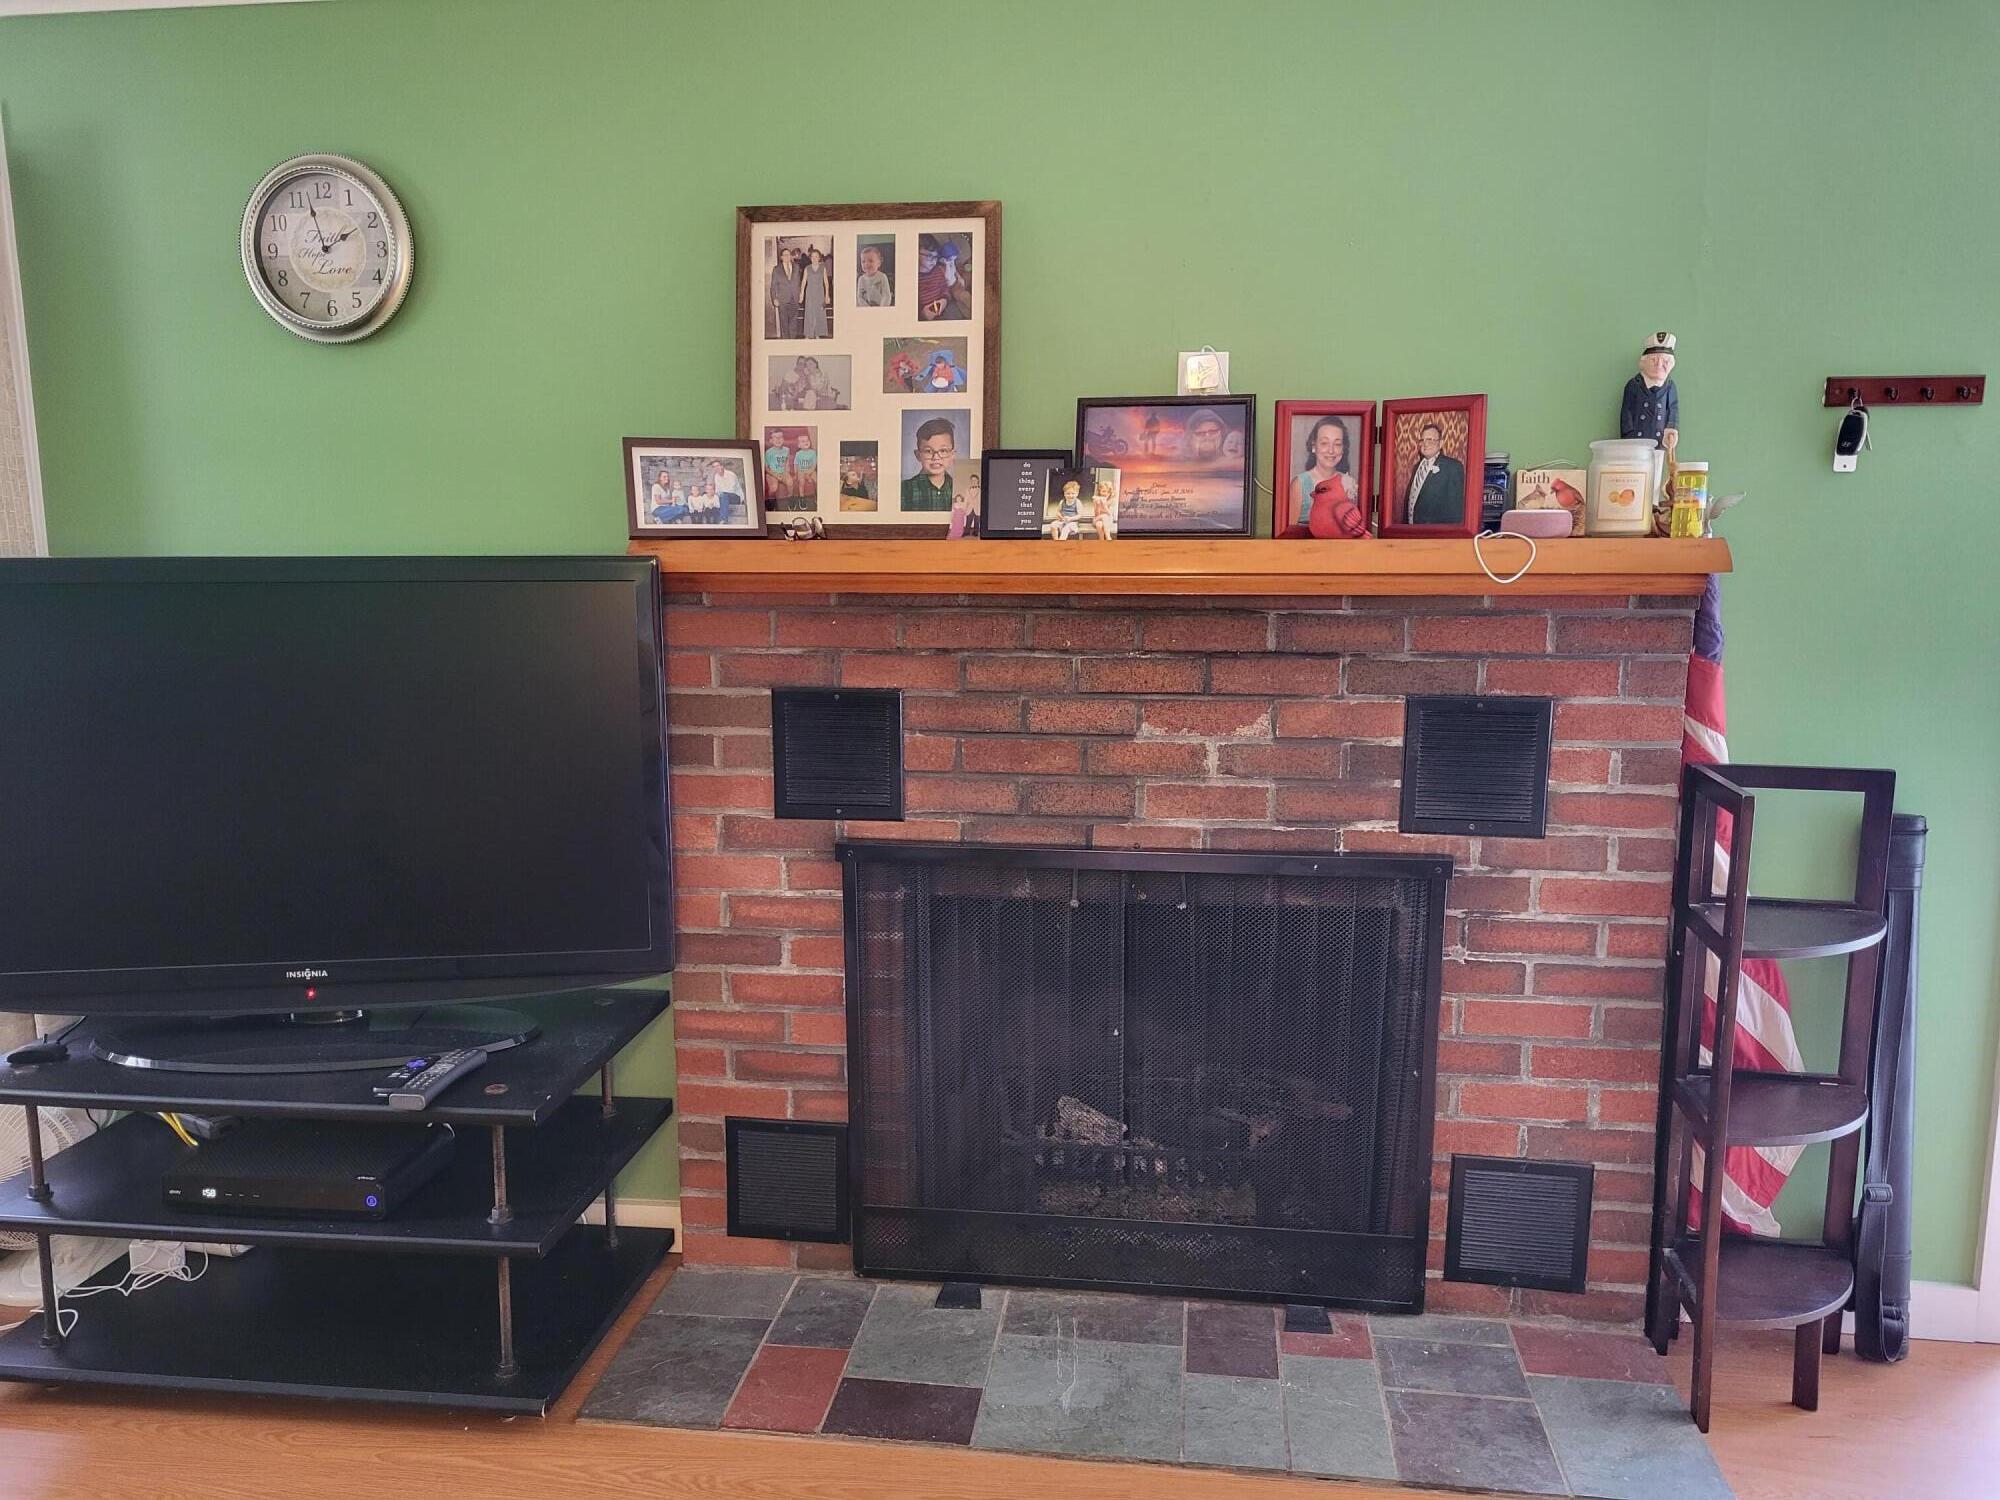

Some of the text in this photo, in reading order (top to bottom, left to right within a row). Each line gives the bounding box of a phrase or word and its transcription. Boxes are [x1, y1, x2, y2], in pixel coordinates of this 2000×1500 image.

[314, 181, 331, 199] 12
[344, 189, 353, 206] 1
[289, 191, 304, 208] 11
[271, 214, 287, 231] 10
[367, 211, 379, 228] 2
[267, 243, 279, 260] 9
[376, 241, 387, 258] 3
[313, 258, 352, 275] Love
[278, 270, 288, 287] 8
[372, 268, 384, 284] 4
[300, 292, 310, 308] 7
[327, 300, 338, 316] 6
[352, 292, 362, 308] 5
[1018, 477, 1035, 485] thing
[1521, 472, 1550, 484] faith
[1021, 493, 1032, 501] day
[286, 968, 328, 979] INSIGNIA
